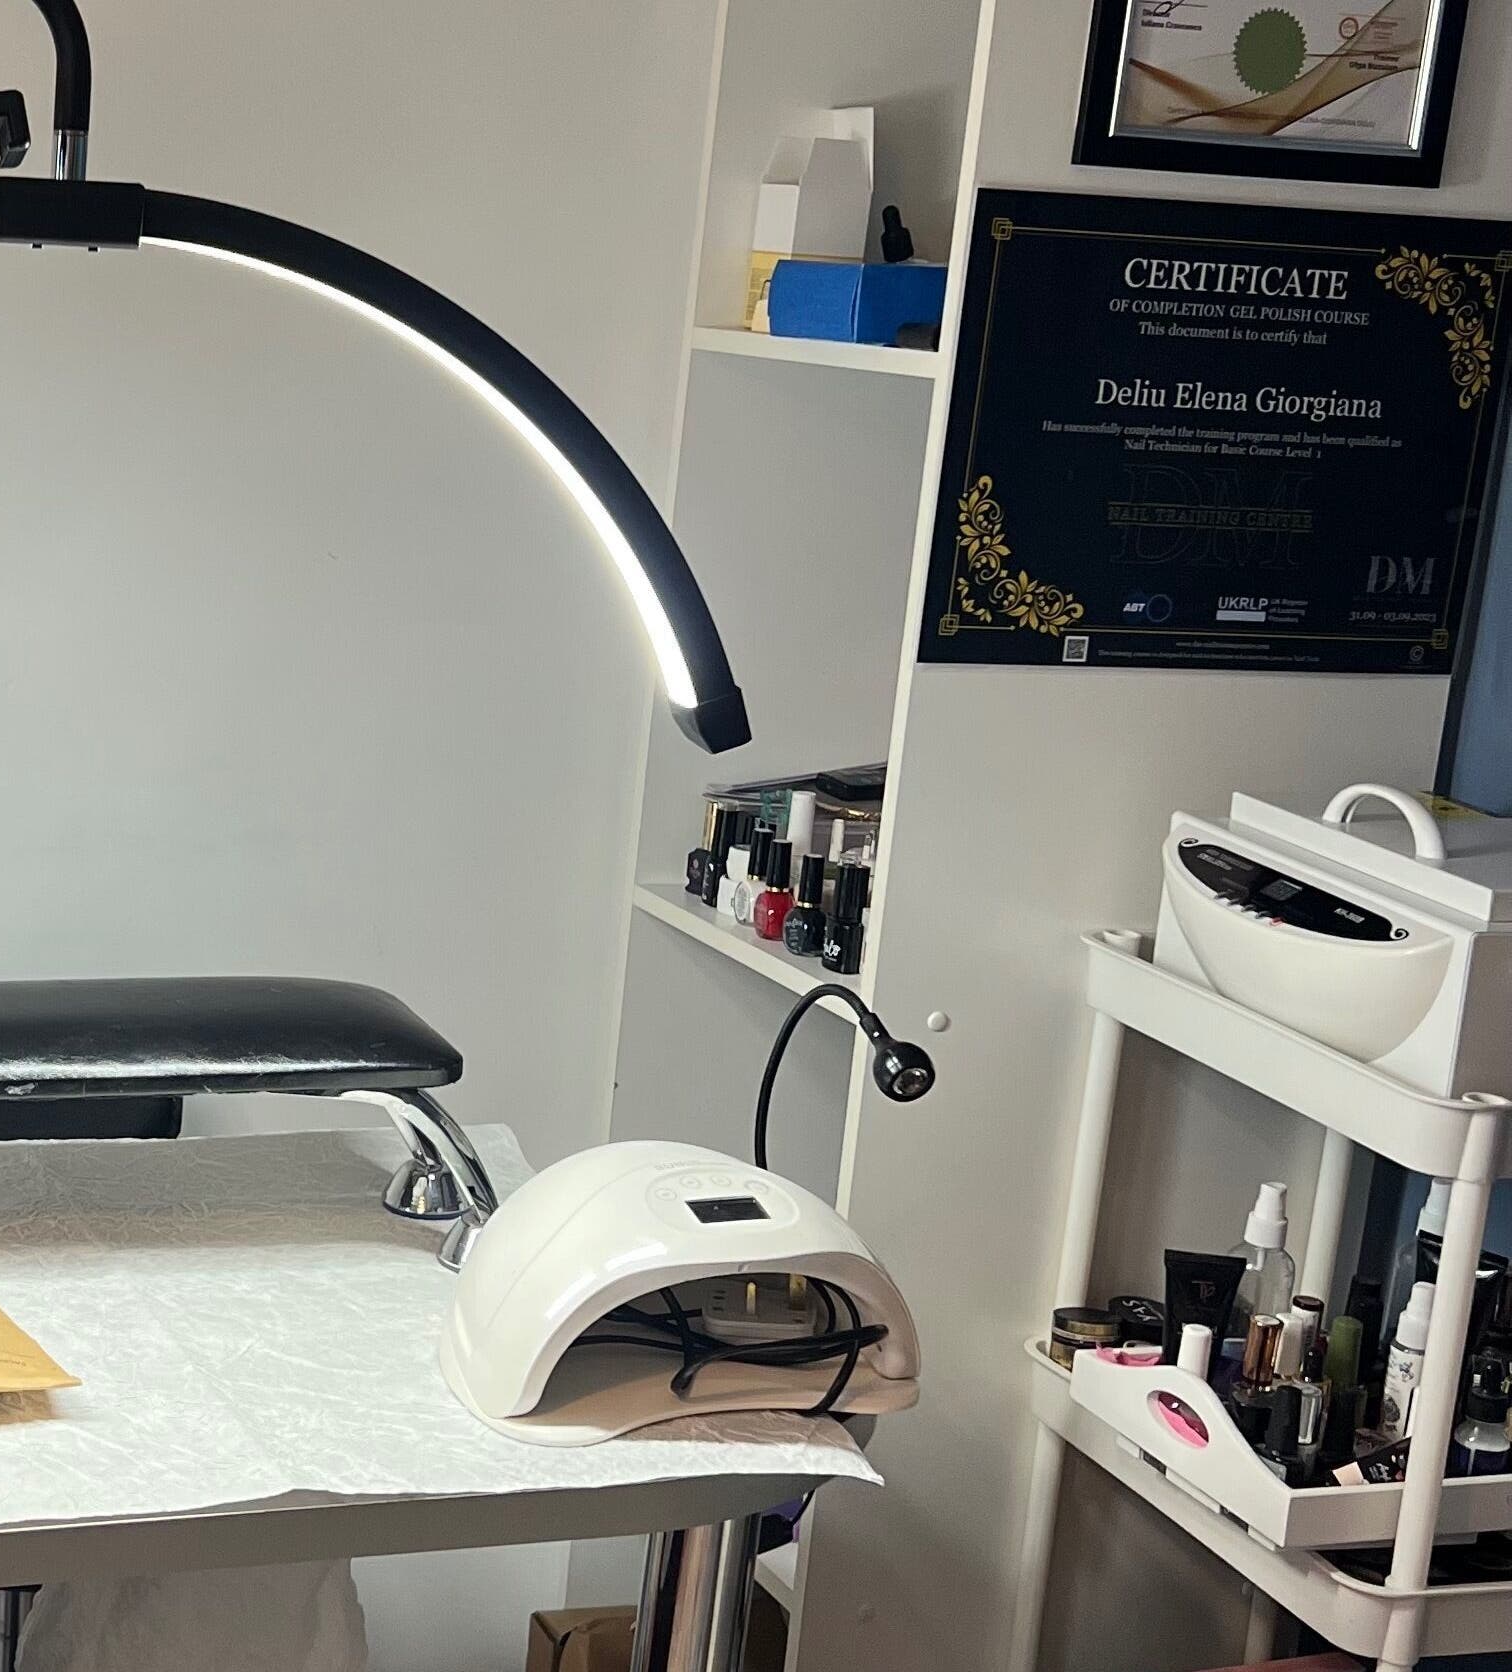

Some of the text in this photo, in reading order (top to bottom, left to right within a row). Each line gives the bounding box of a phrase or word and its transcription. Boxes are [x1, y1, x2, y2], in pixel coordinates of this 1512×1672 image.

[1123, 257, 1349, 300] CERTIFICATE
[1109, 299, 1370, 325] OF COMPLETION GEL POLISH COURSE
[1138, 321, 1327, 347] This document is to certify that
[1094, 378, 1382, 422] Deliu Elena Giorgiana
[1177, 426, 1194, 438] the
[1237, 431, 1279, 443] program
[1123, 438, 1146, 451] Nail
[1148, 440, 1202, 453] Technician
[1203, 443, 1218, 454] for
[1248, 445, 1283, 457] Course
[1286, 446, 1313, 458] Level
[1108, 505, 1149, 522] NAIL
[1154, 508, 1240, 527] TRAINING
[1366, 555, 1439, 595] DM
[1218, 596, 1269, 611] UKRLP
